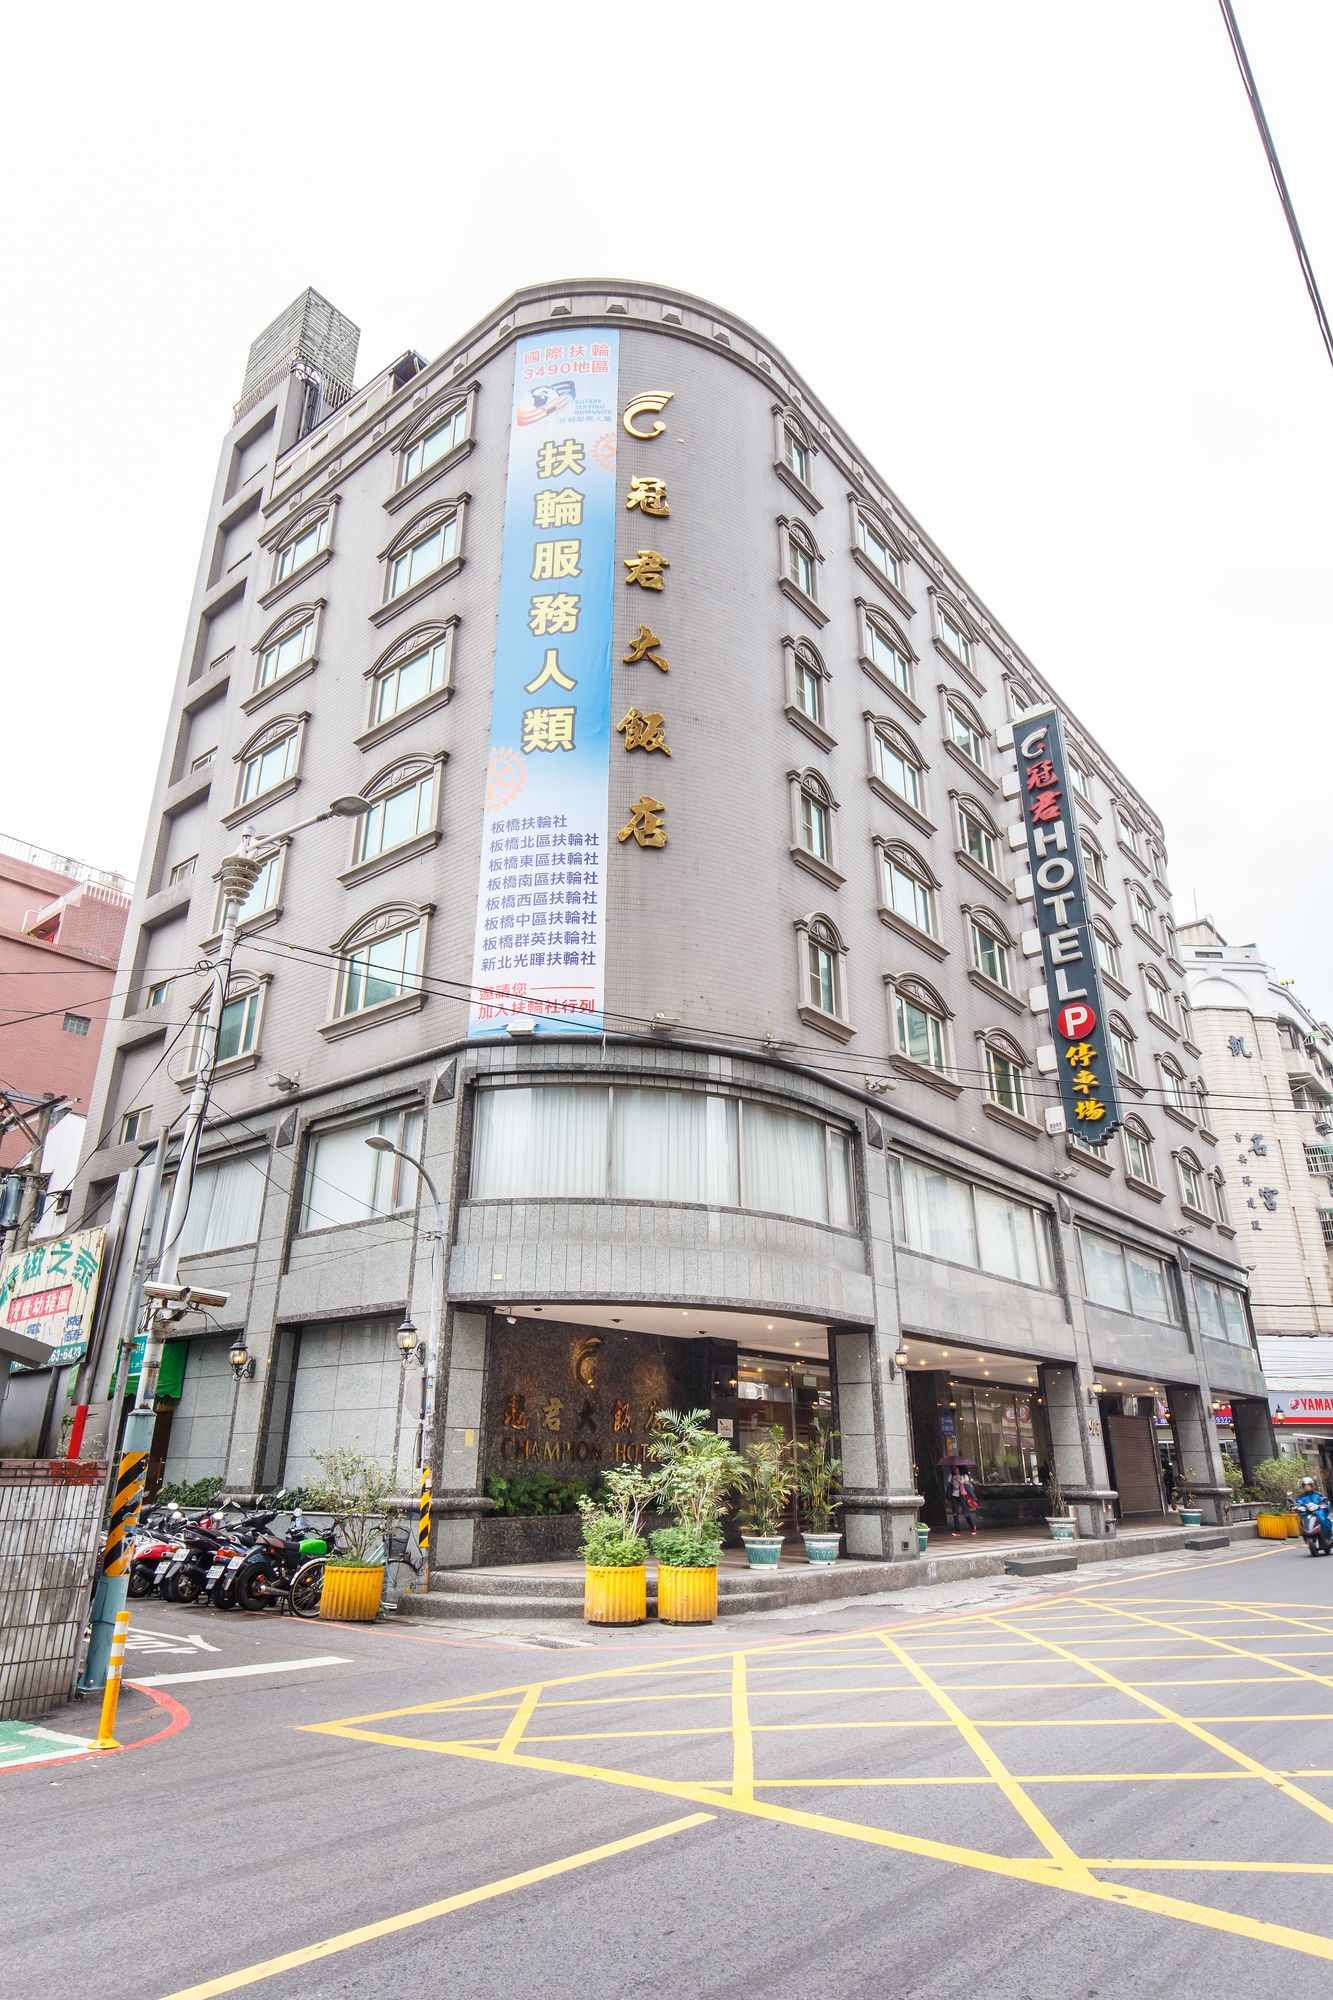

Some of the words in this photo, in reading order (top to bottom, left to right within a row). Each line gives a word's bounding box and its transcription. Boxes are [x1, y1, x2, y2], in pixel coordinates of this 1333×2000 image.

[524, 344, 609, 364] 國際扶輪
[523, 361, 609, 380] 3490地區
[521, 439, 586, 753] 扶輪服務人類
[617, 475, 673, 848] 冠君大飯店
[491, 814, 568, 835] 板橋扶輪社
[489, 832, 600, 854] 板橋北區扶輪社
[488, 851, 599, 872] 板橋東區扶輪社
[486, 871, 599, 892] 板橋南區扶輪社
[485, 890, 598, 911] 板橋西區扶輪社
[1033, 820, 1088, 1000] HOTEL
[483, 910, 598, 931] 板橋中區扶輪社
[482, 930, 597, 951] 板橋群英扶輪社
[481, 950, 596, 972] 新北光暉扶輪社
[479, 982, 527, 1001] 邀請您
[478, 998, 595, 1020] 加入扶輪社行列
[1066, 1042, 1106, 1121] 停車場
[502, 1438, 602, 1463] CHAMPION
